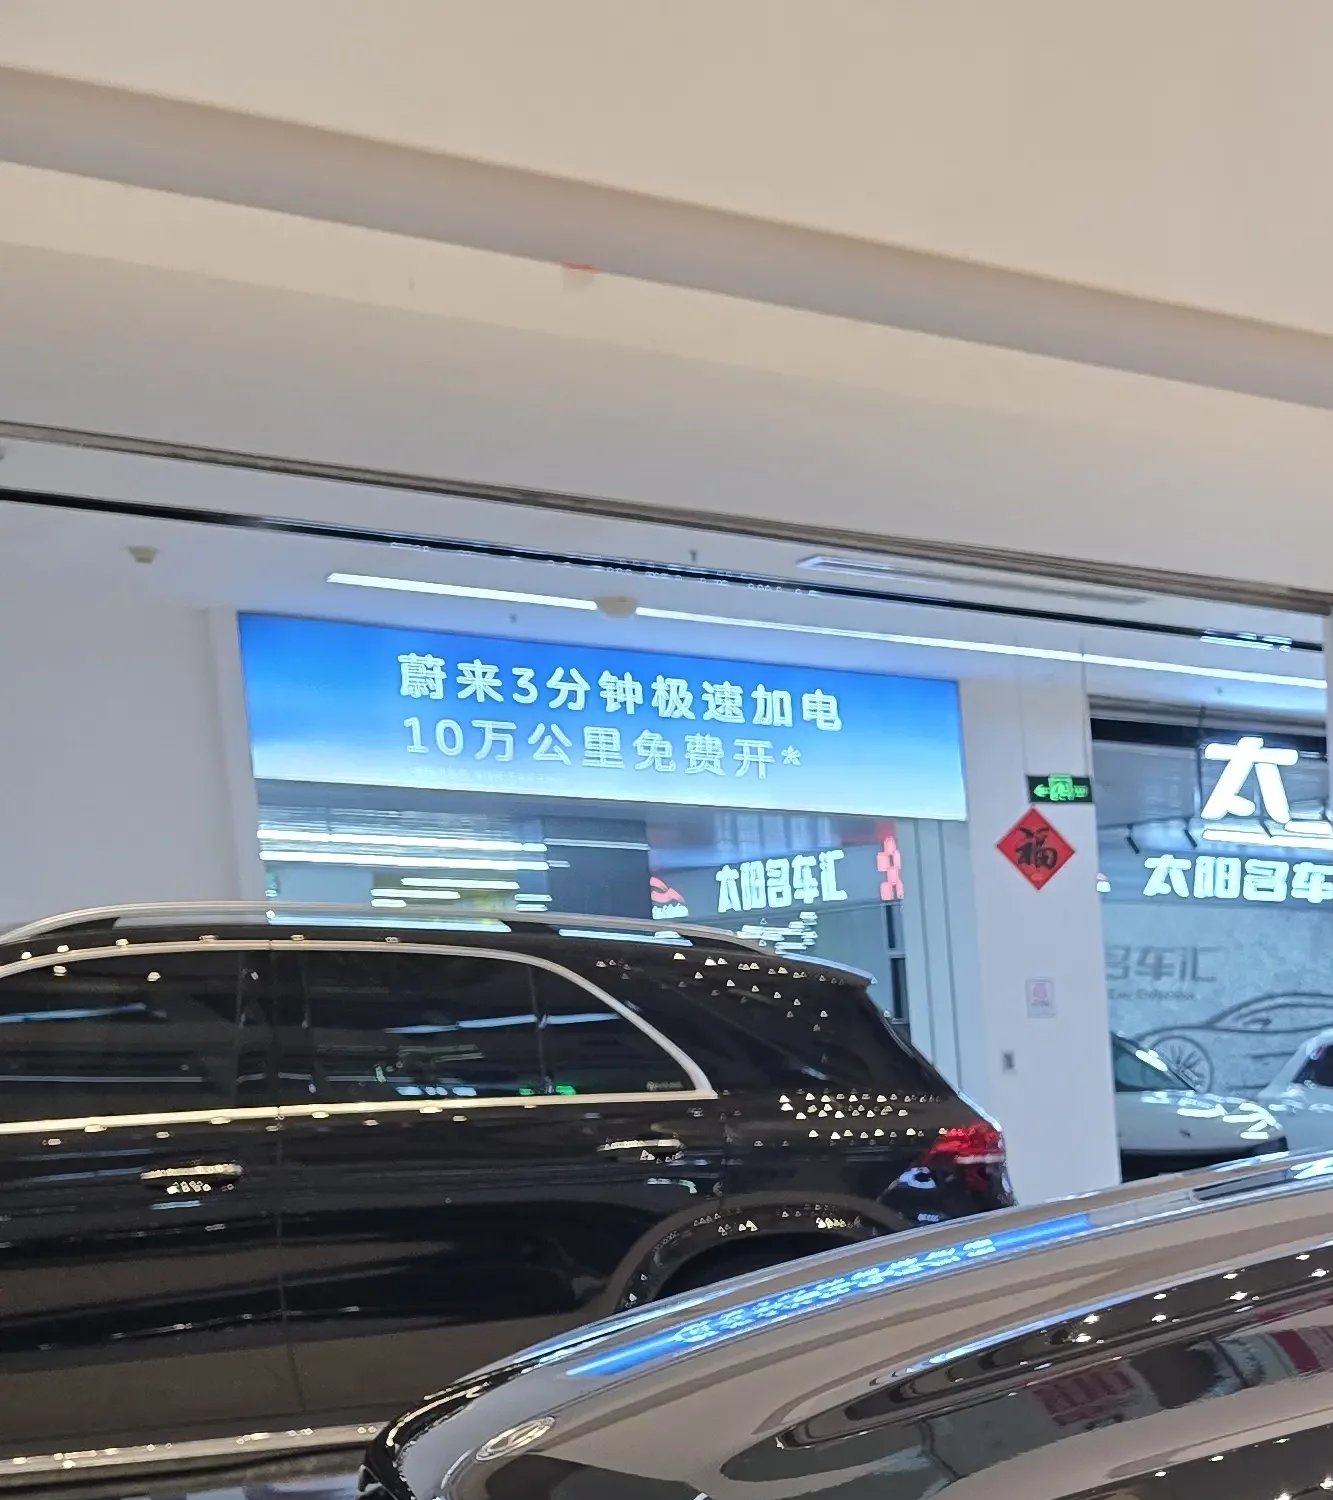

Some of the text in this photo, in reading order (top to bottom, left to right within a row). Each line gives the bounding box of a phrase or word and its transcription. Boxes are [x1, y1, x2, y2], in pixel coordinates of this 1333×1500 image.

[397, 652, 842, 732] 蔚来3分钟极速加电
